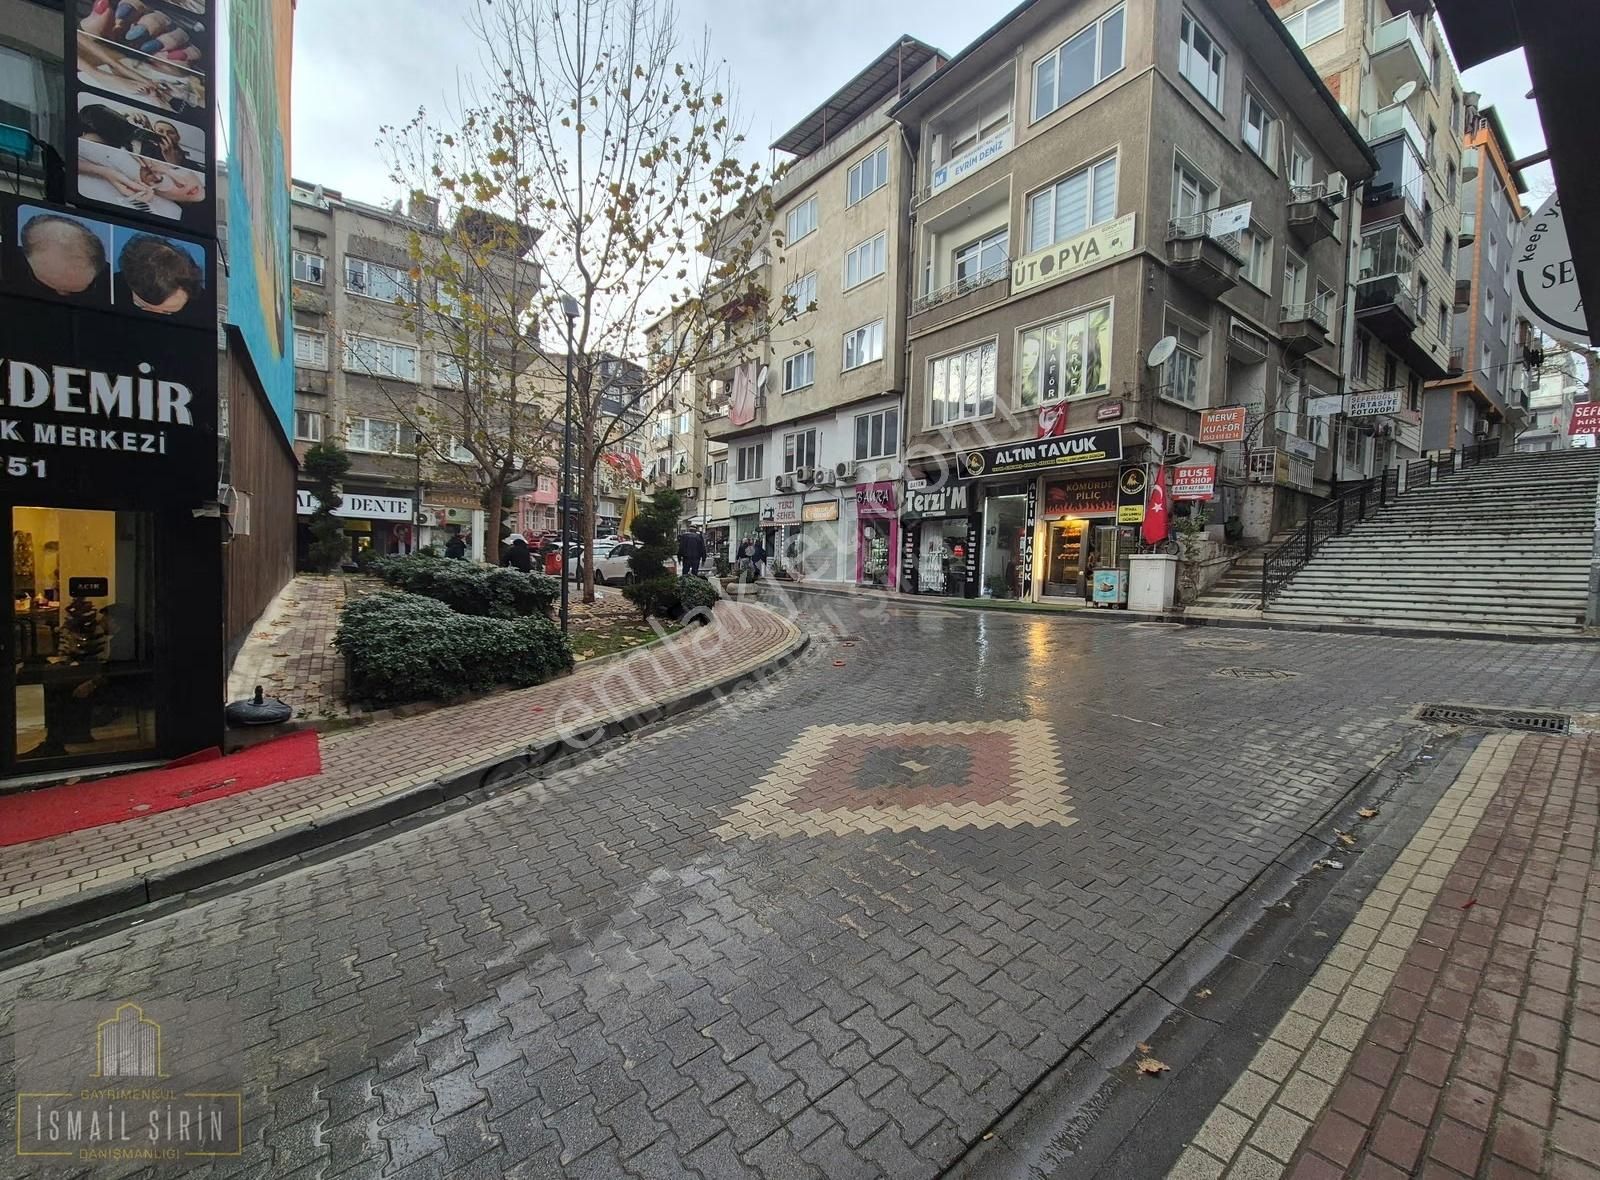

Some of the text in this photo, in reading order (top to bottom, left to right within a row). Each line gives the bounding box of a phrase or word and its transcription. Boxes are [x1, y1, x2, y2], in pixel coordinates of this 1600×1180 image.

[955, 155, 978, 176] EVRİM
[979, 141, 1003, 161] DENİZ
[1518, 223, 1548, 263] keep
[1542, 259, 1575, 289] SE
[1048, 329, 1057, 398] KUAFÖR
[1070, 331, 1080, 386] MERVE
[1203, 422, 1240, 434] KUAFÖR
[1207, 412, 1238, 423] MERVE
[33, 421, 166, 454] MERKEZİ
[995, 436, 1097, 465] ALTIN TAVUK
[1066, 480, 1114, 491] KÖMÜRDE
[1179, 468, 1210, 477] BUSE
[351, 498, 407, 513] DENTE
[906, 486, 967, 512] Terzi'M
[1027, 482, 1036, 527] ALTIN
[1076, 490, 1101, 500] PİLİÇ
[1024, 536, 1033, 581] TAVUK
